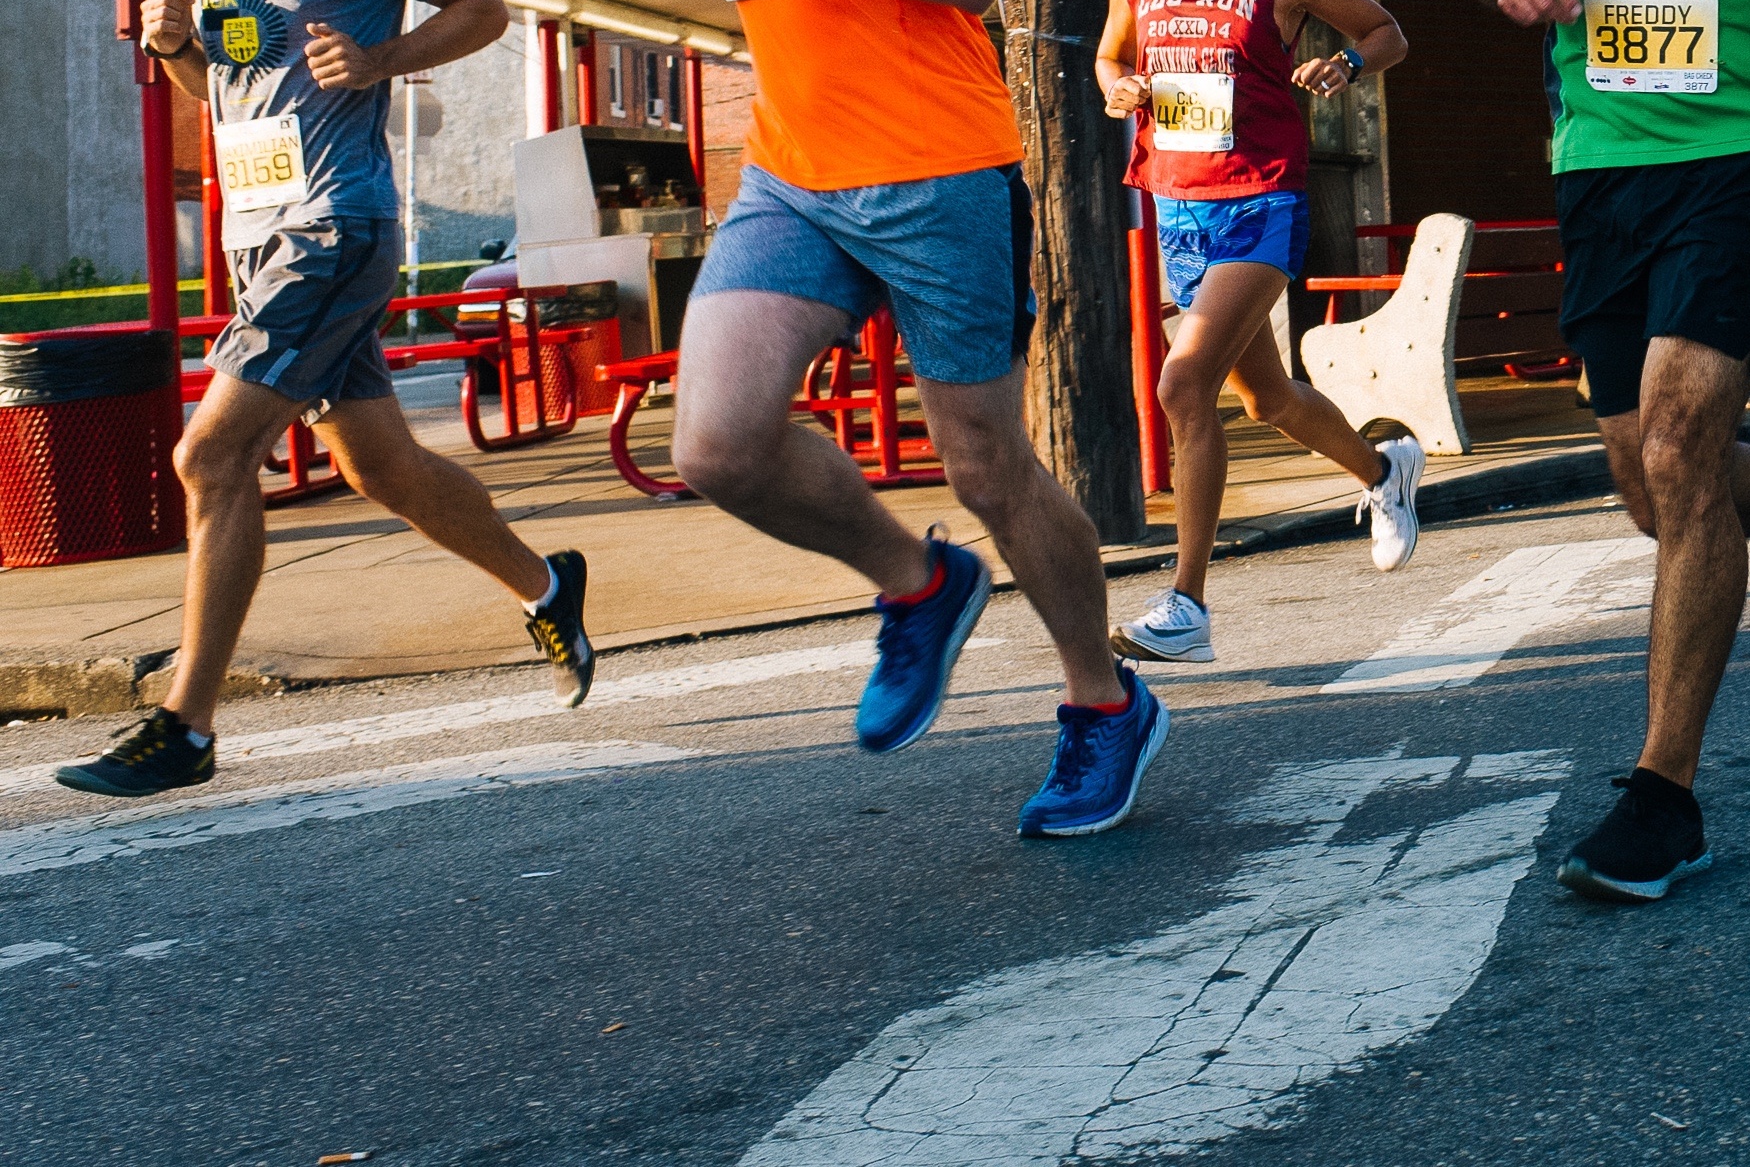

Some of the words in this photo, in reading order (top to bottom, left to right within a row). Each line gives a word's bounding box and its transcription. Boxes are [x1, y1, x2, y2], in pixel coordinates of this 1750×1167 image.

[1604, 5, 1692, 24] FREDDY
[1148, 20, 1168, 38] 20
[1173, 20, 1204, 35] XXL
[1210, 22, 1231, 38] 14
[1596, 26, 1704, 64] 3877
[1145, 47, 1197, 73] RUNNING
[1177, 91, 1201, 105] C.C.
[1157, 105, 1226, 131] 4490
[225, 153, 293, 189] 3159
